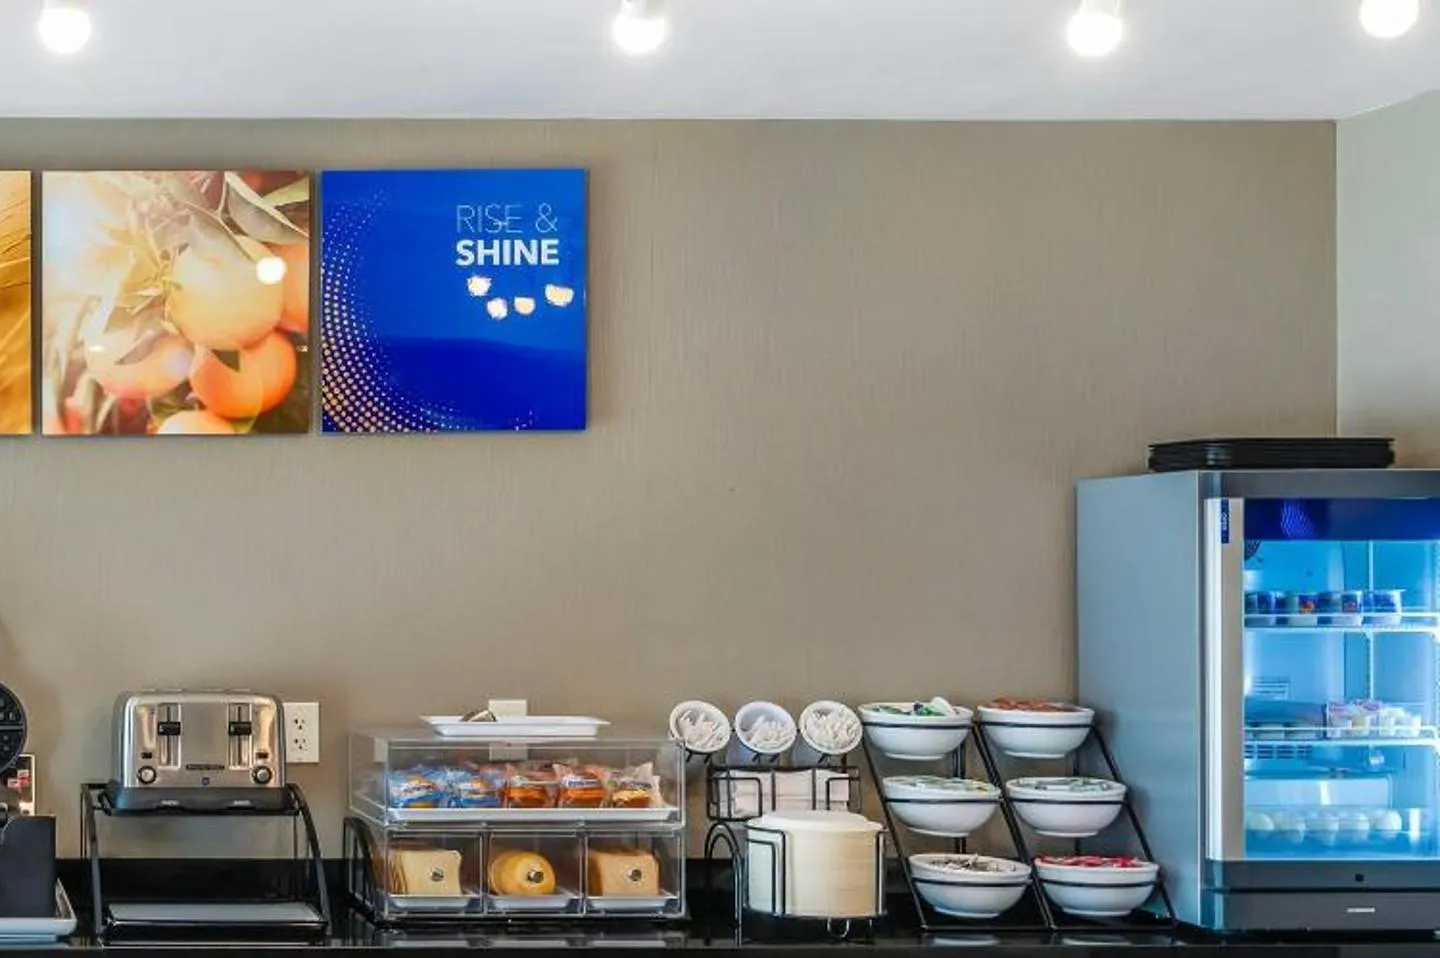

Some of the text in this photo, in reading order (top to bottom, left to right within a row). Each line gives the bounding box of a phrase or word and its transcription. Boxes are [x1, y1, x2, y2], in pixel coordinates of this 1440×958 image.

[456, 202, 559, 233] RISE &
[455, 238, 561, 267] SHINE
